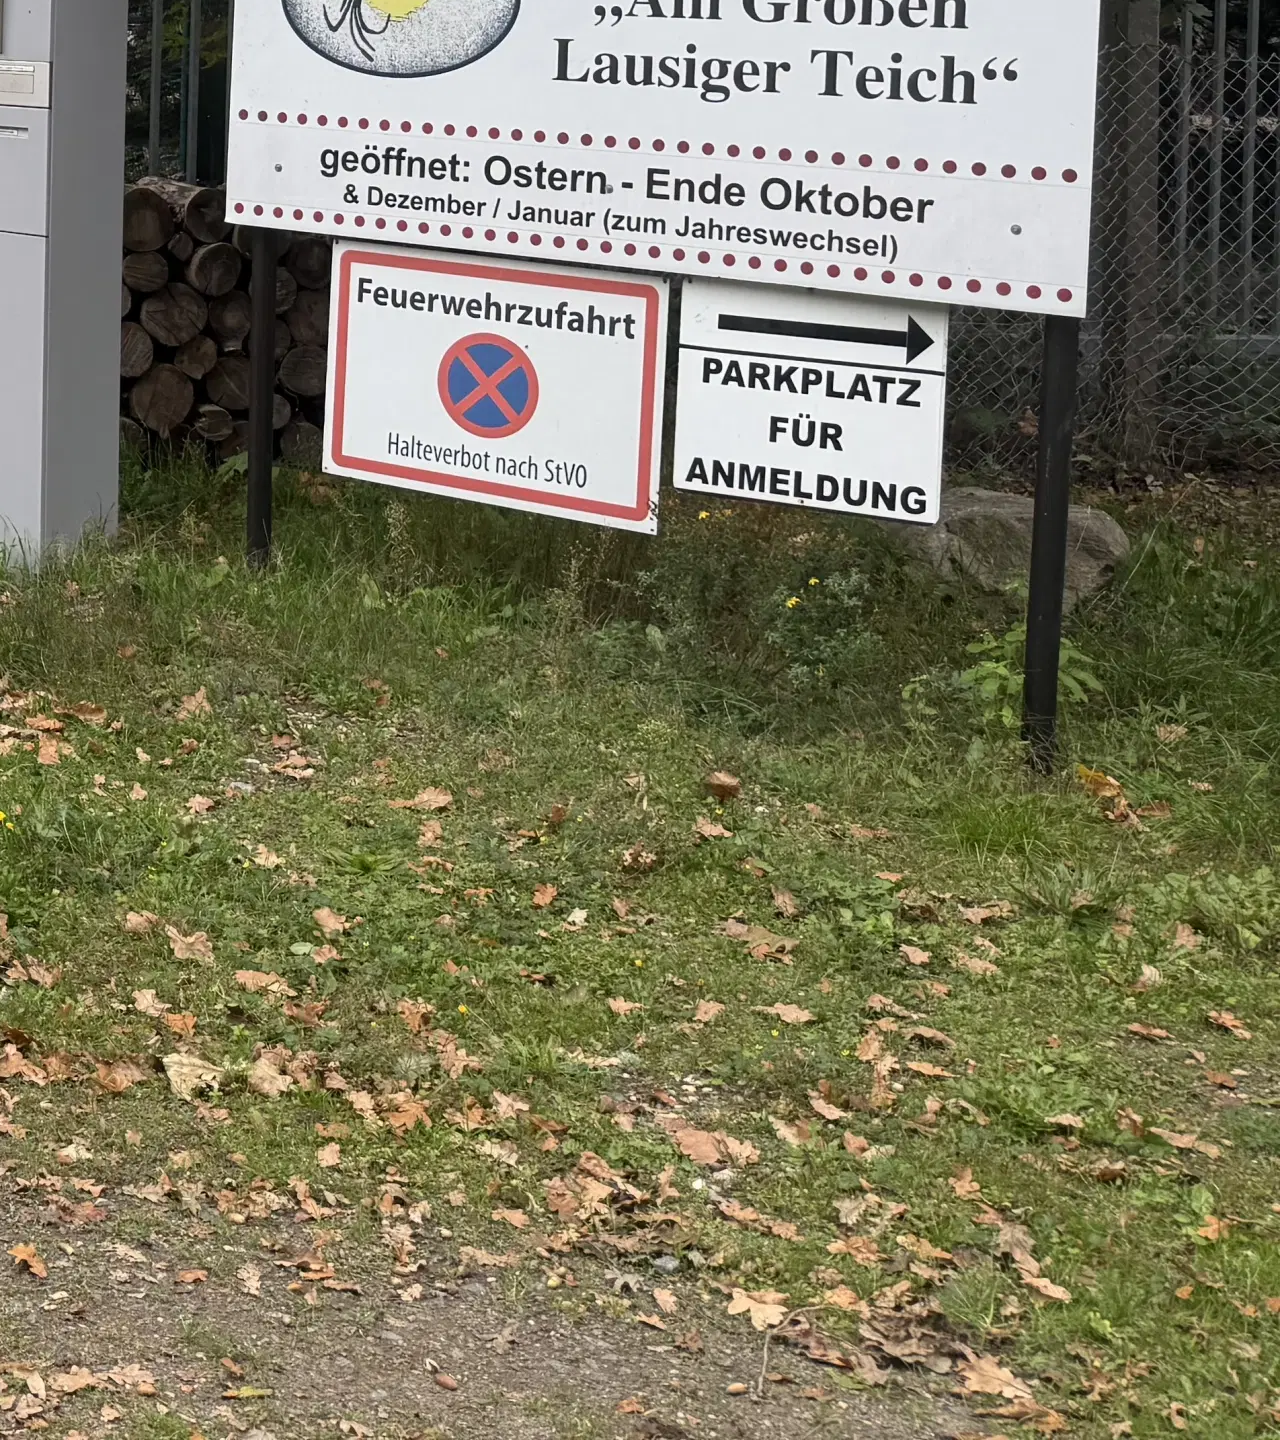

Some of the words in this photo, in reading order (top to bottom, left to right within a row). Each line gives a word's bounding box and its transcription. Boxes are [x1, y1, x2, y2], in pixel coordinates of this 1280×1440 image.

[551, 37, 792, 104] Lausiger
[809, 49, 1020, 105] Teich“
[320, 144, 471, 183] geöffnet:
[483, 154, 607, 195] Ostern
[645, 167, 746, 207] Ende
[759, 176, 935, 224] Oktober
[342, 183, 359, 204] &
[366, 185, 487, 217] Dezember
[492, 197, 501, 218] /
[507, 199, 596, 228] Januar
[602, 207, 667, 236] (zum
[674, 215, 899, 265] Jahreswechsel)
[357, 276, 637, 340] Feuerwehrzufahrt
[702, 356, 923, 408] PARKPLATZ
[387, 431, 491, 472] Halteverbot
[495, 455, 539, 481] nach
[543, 458, 589, 489] StVO
[768, 413, 844, 452] FÜR
[684, 456, 928, 516] ANMELDUNG
